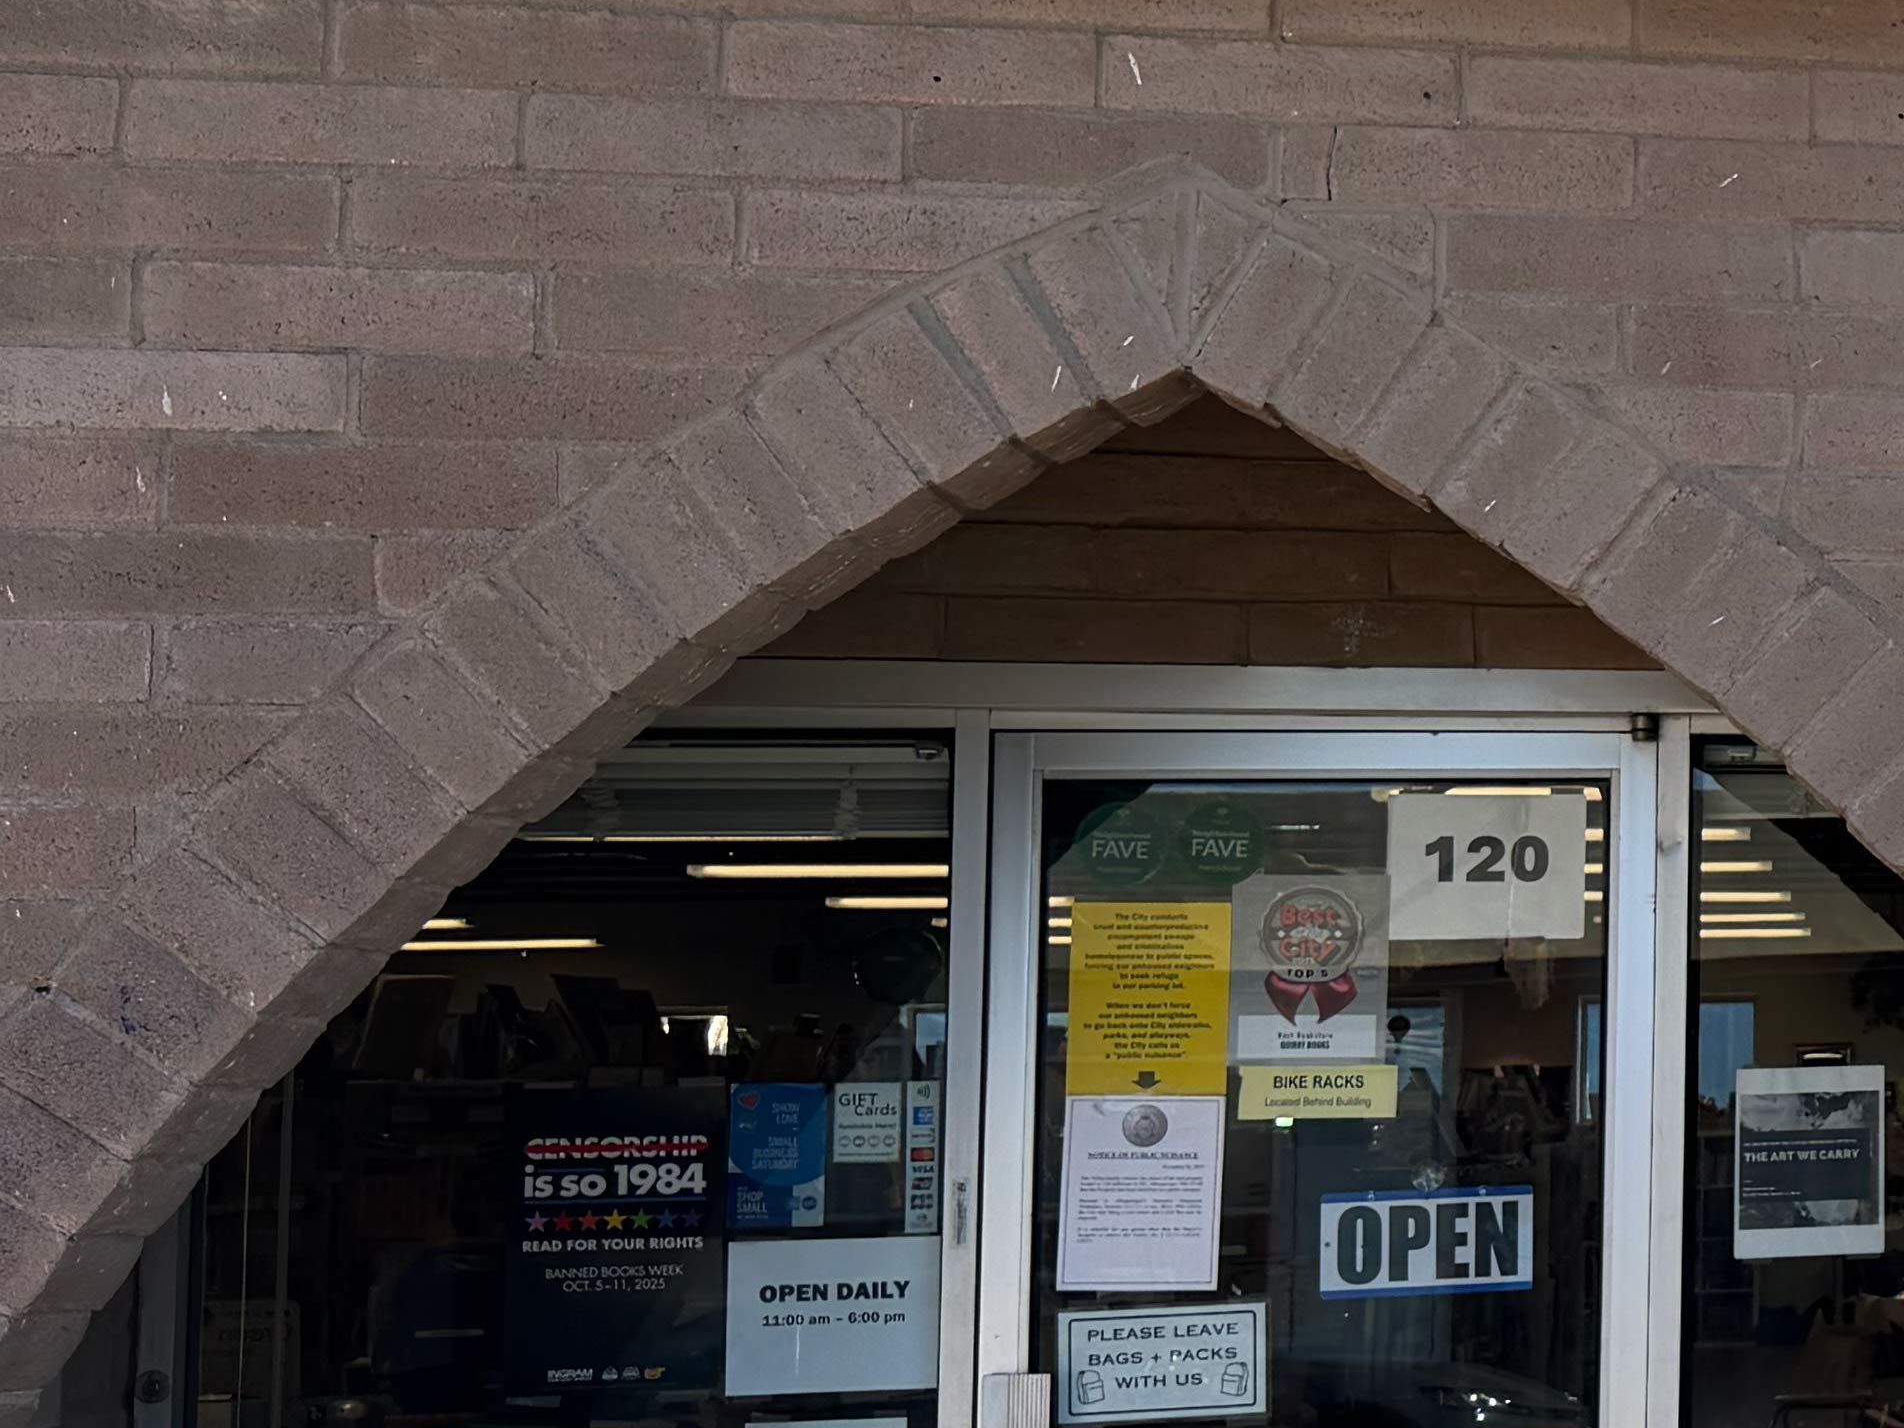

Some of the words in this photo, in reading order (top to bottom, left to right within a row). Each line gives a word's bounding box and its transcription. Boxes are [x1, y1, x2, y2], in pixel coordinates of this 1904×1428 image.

[1091, 839, 1151, 859] FAVE
[1191, 838, 1250, 858] FAVE
[1424, 835, 1550, 884] 120
[1280, 905, 1338, 927] Best
[1279, 939, 1337, 963] City
[1287, 969, 1314, 978] TOP
[1273, 1075, 1307, 1089] BIKE
[1313, 1074, 1365, 1089] RACKS
[838, 1093, 878, 1106] GIFT
[855, 1103, 897, 1116] Cards
[1264, 1097, 1301, 1107] Located
[1303, 1097, 1334, 1107] Behind
[1336, 1097, 1372, 1109] Building
[526, 1133, 708, 1160] CENSORSHIP
[1743, 1151, 1769, 1164] THE
[1770, 1151, 1795, 1163] ART
[1795, 1149, 1817, 1161] WE
[1819, 1148, 1860, 1160] CARRY
[523, 1163, 554, 1199] is
[560, 1174, 607, 1198] so
[613, 1161, 708, 1196] 1984
[521, 1239, 562, 1253] READ
[567, 1238, 598, 1251] FOR
[600, 1237, 645, 1250] YOUR
[649, 1236, 703, 1249] RIGHTS
[1336, 1201, 1520, 1286] OPEN
[545, 1266, 598, 1280] BANNED
[601, 1265, 646, 1278] BOOKS
[647, 1263, 684, 1276] WEEK
[562, 1279, 594, 1292] OCT.
[635, 1278, 666, 1290] 2025
[758, 1282, 829, 1305] OPEN
[836, 1280, 911, 1303] DAILY
[762, 1312, 805, 1328] 11:00
[808, 1313, 832, 1325] am
[848, 1310, 880, 1325] 6:00
[883, 1312, 906, 1327] pm
[1087, 1324, 1167, 1344] PLEASE
[1173, 1320, 1239, 1339] LEAVE
[1087, 1348, 1143, 1367] BAGS
[1169, 1344, 1238, 1363] PACKS
[1114, 1373, 1166, 1391] WITH
[1175, 1371, 1203, 1387] US
